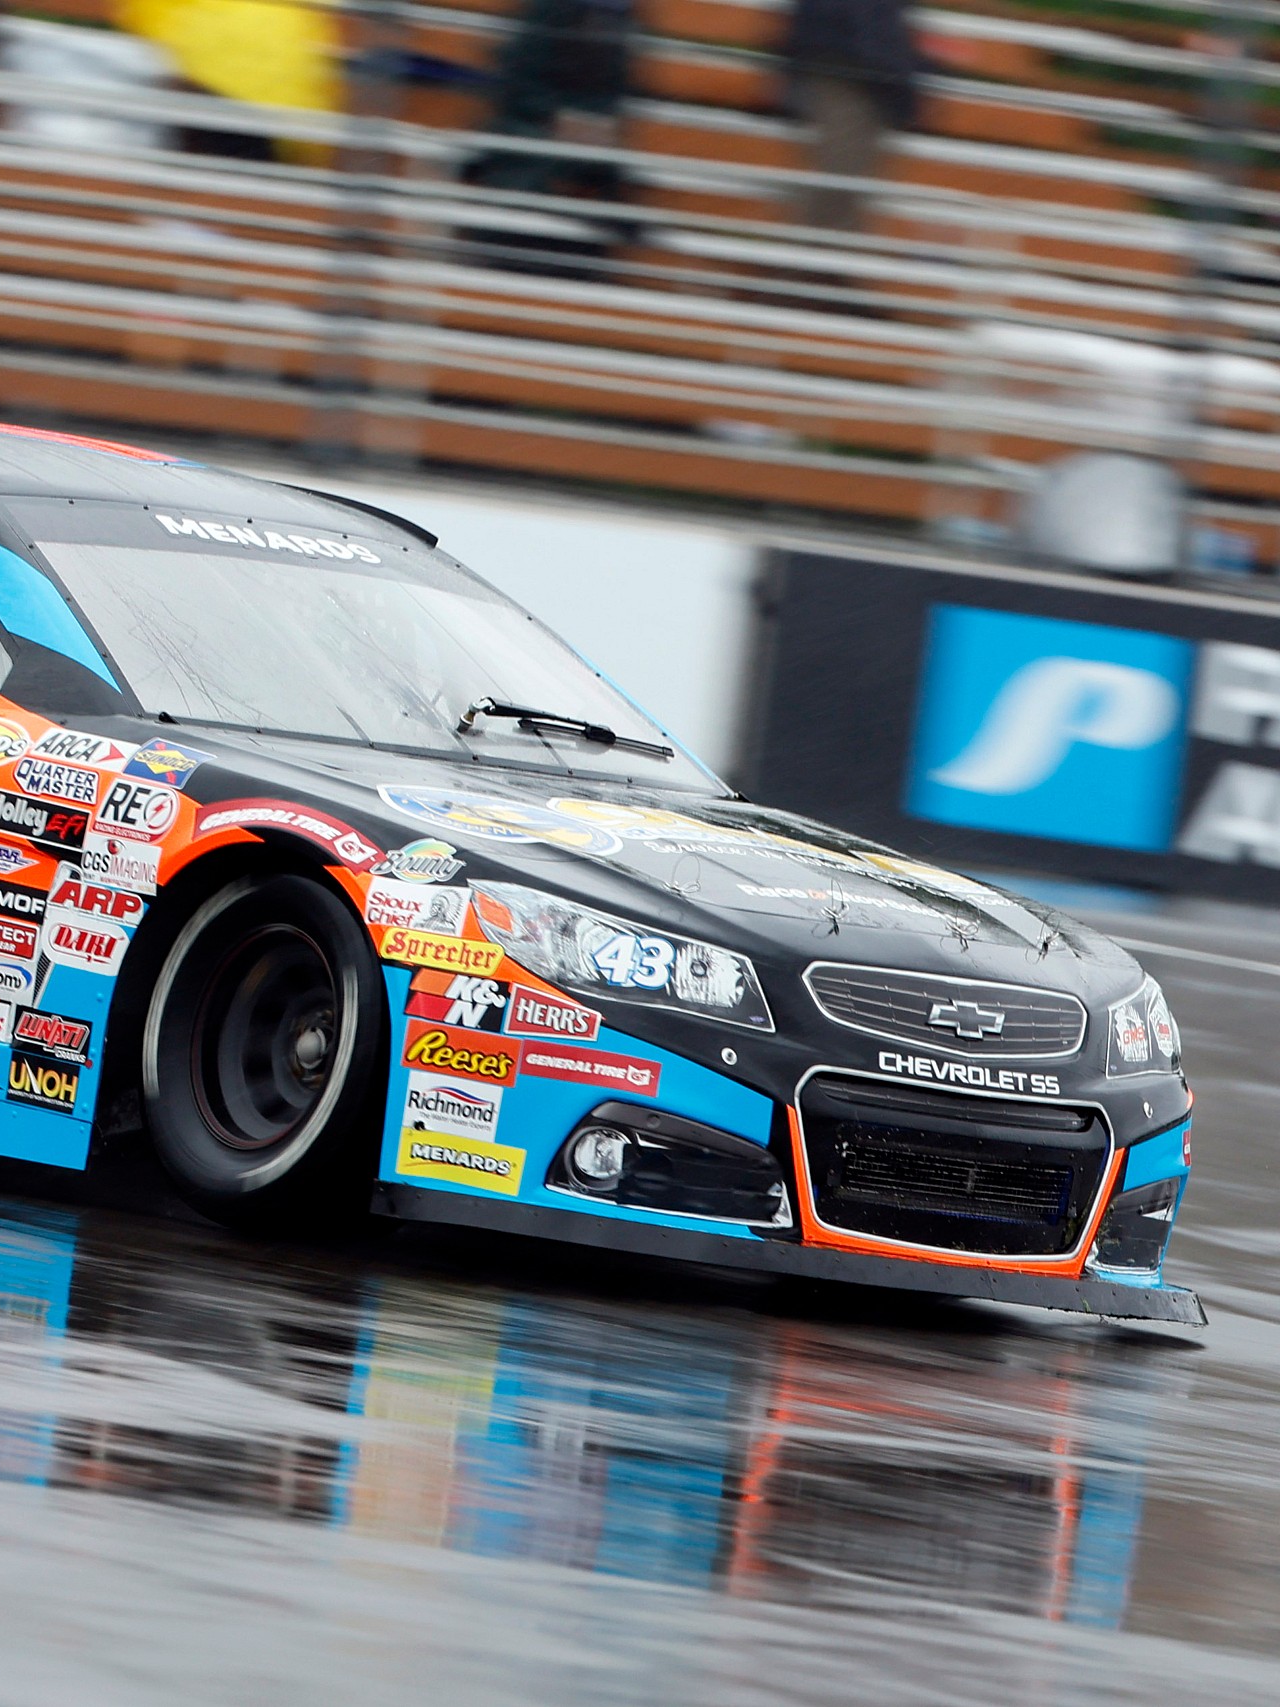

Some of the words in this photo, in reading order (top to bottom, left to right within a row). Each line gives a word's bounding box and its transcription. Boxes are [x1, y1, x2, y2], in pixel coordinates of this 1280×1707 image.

[156, 514, 381, 564] MENARDS
[35, 732, 103, 762] ARCA
[17, 759, 96, 787] QUARTER
[26, 775, 95, 802] MASTER
[199, 808, 294, 831] GENERAL
[294, 815, 343, 841] TIRE
[51, 880, 141, 918] ARP
[369, 891, 422, 914] Sioux
[367, 906, 416, 927] Chief
[384, 929, 497, 969] Sprecher
[593, 932, 676, 990] 43
[18, 1014, 86, 1049] LUNATI
[516, 998, 591, 1033] HERR'S
[406, 1030, 515, 1079] Reese's
[525, 1053, 592, 1074] GENERAL
[592, 1062, 627, 1079] TIRE
[9, 1058, 79, 1104] UNOH
[878, 1051, 1029, 1092] CHEVROLET
[1030, 1073, 1060, 1096] SS
[408, 1089, 495, 1123] Richmond
[410, 1142, 511, 1176] MENARDS
